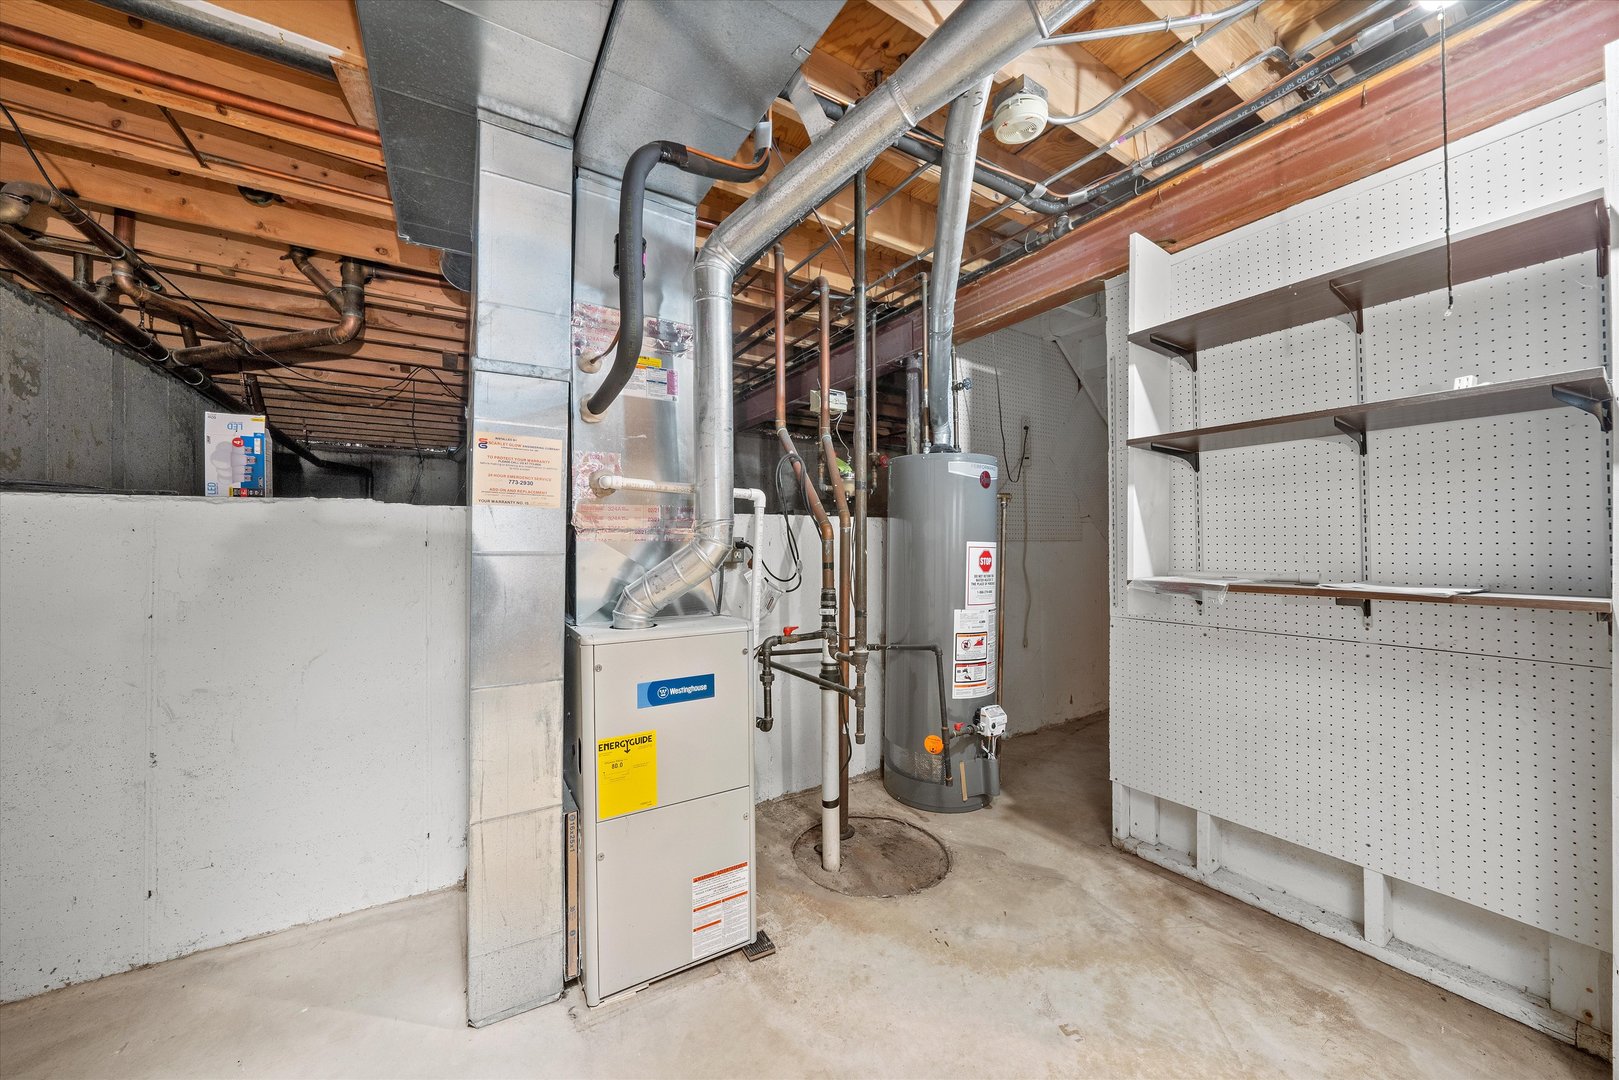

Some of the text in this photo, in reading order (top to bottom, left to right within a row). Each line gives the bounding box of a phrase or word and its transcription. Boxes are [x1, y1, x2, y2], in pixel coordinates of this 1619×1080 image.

[1296, 67, 1319, 83] 25/50
[980, 557, 991, 566] STOP
[670, 684, 707, 695] Westinghouse
[598, 735, 653, 752] ENERGYGUIDE
